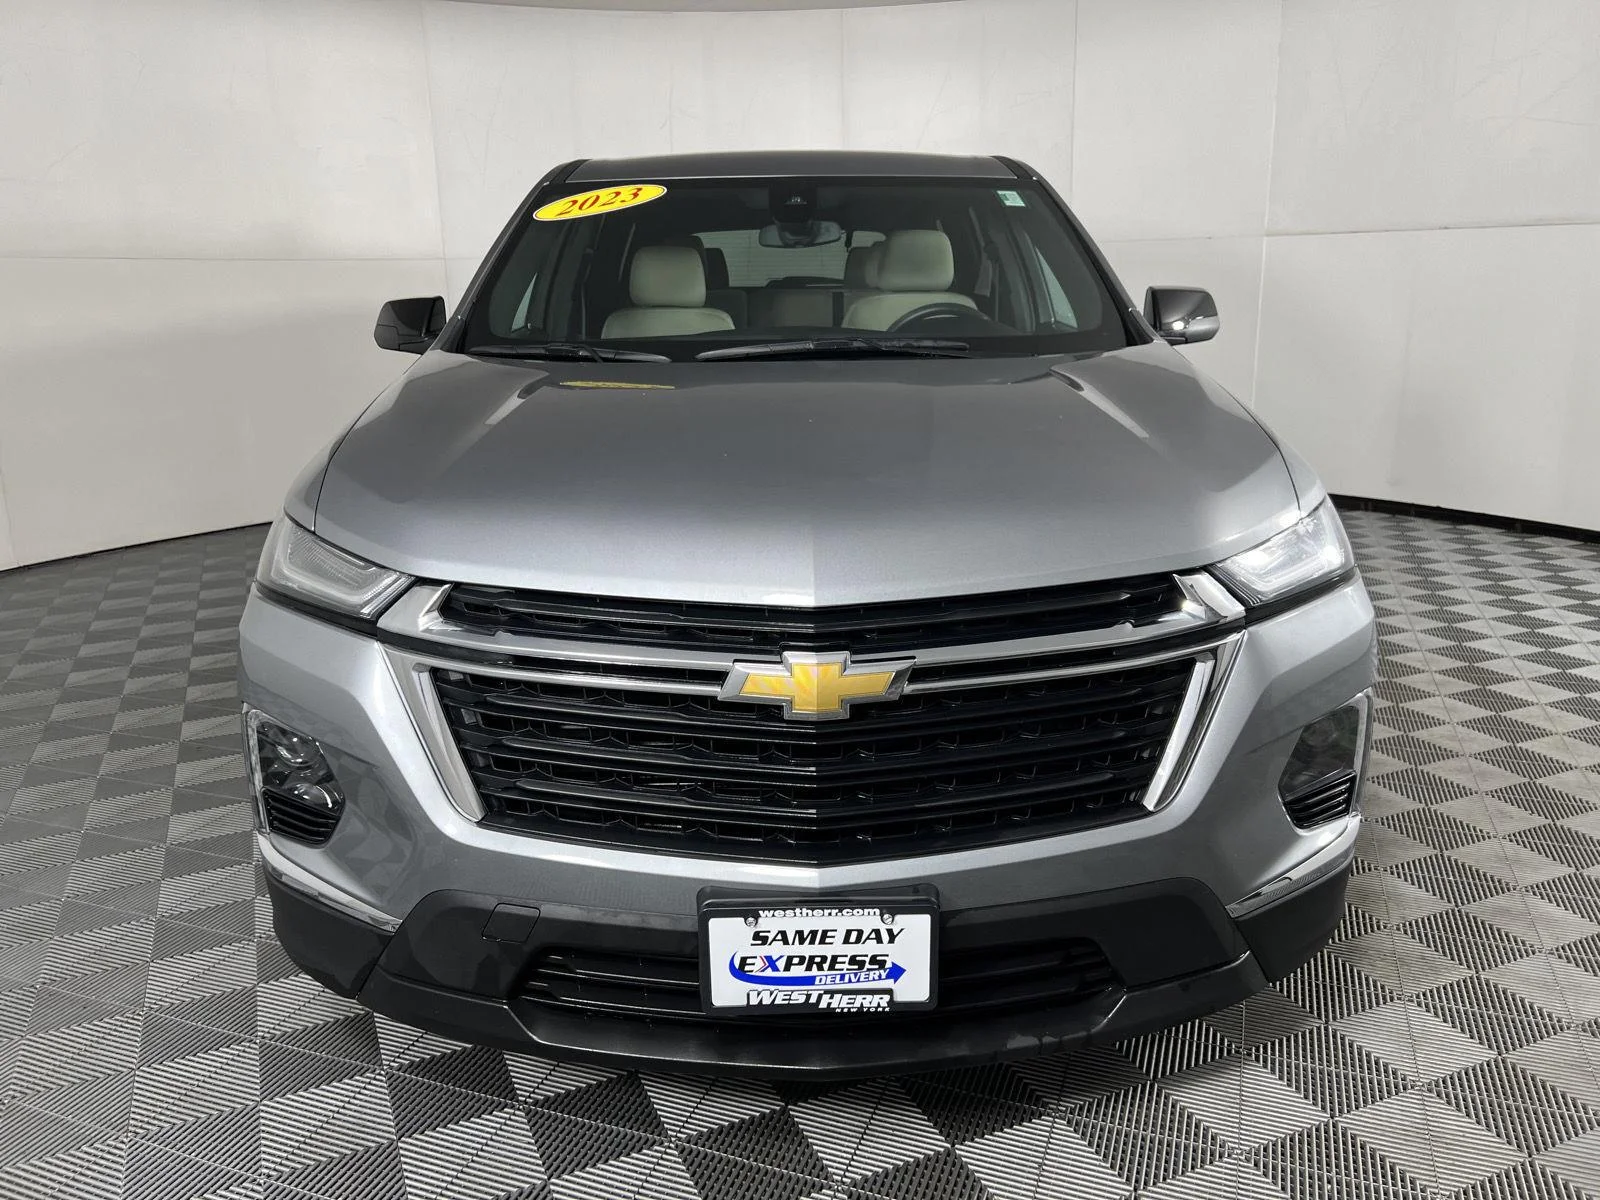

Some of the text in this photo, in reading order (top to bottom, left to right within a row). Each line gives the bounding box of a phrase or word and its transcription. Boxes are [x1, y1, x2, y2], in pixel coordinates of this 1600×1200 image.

[556, 187, 643, 217] 2023
[758, 908, 881, 918] westherr.com
[750, 927, 905, 946] SAME DAY
[738, 954, 889, 973] EXPRESS
[815, 969, 889, 985] DELIVERY
